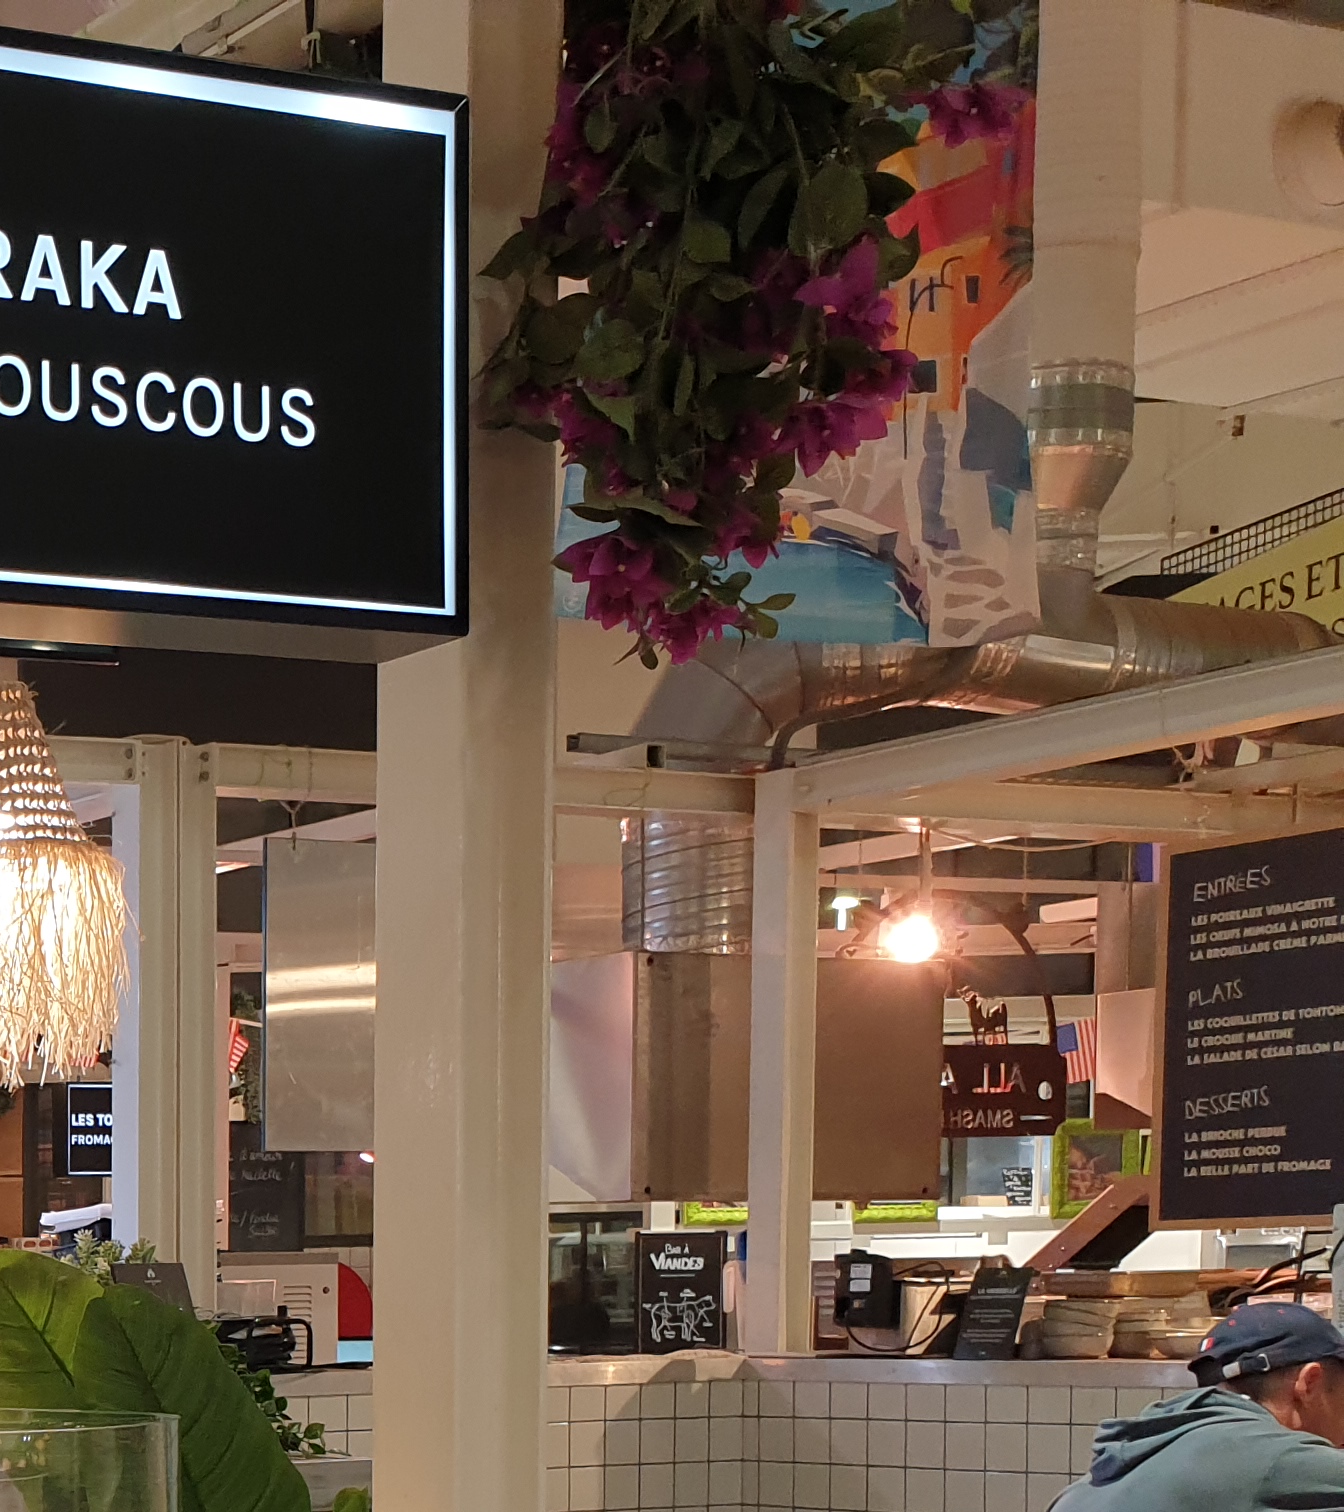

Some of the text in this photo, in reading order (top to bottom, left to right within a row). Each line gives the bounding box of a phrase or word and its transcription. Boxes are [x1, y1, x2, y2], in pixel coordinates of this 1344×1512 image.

[1193, 864, 1271, 902] ENTRÉES
[1190, 949, 1204, 962] LA
[1188, 978, 1244, 1009] PLATS
[1282, 1009, 1296, 1021] DE
[1187, 1037, 1199, 1049] LE
[1187, 1054, 1201, 1066] LA
[1184, 1085, 1271, 1120] DESSERTS
[72, 1113, 95, 1127] LES
[71, 1134, 113, 1145] FROMA
[1184, 1131, 1199, 1143] LA
[1184, 1150, 1199, 1161] LA
[1242, 1144, 1281, 1157] CHOCO
[1183, 1166, 1198, 1177] LA
[1277, 1159, 1332, 1172] FROMAGE
[649, 1252, 705, 1270] VIANDES
